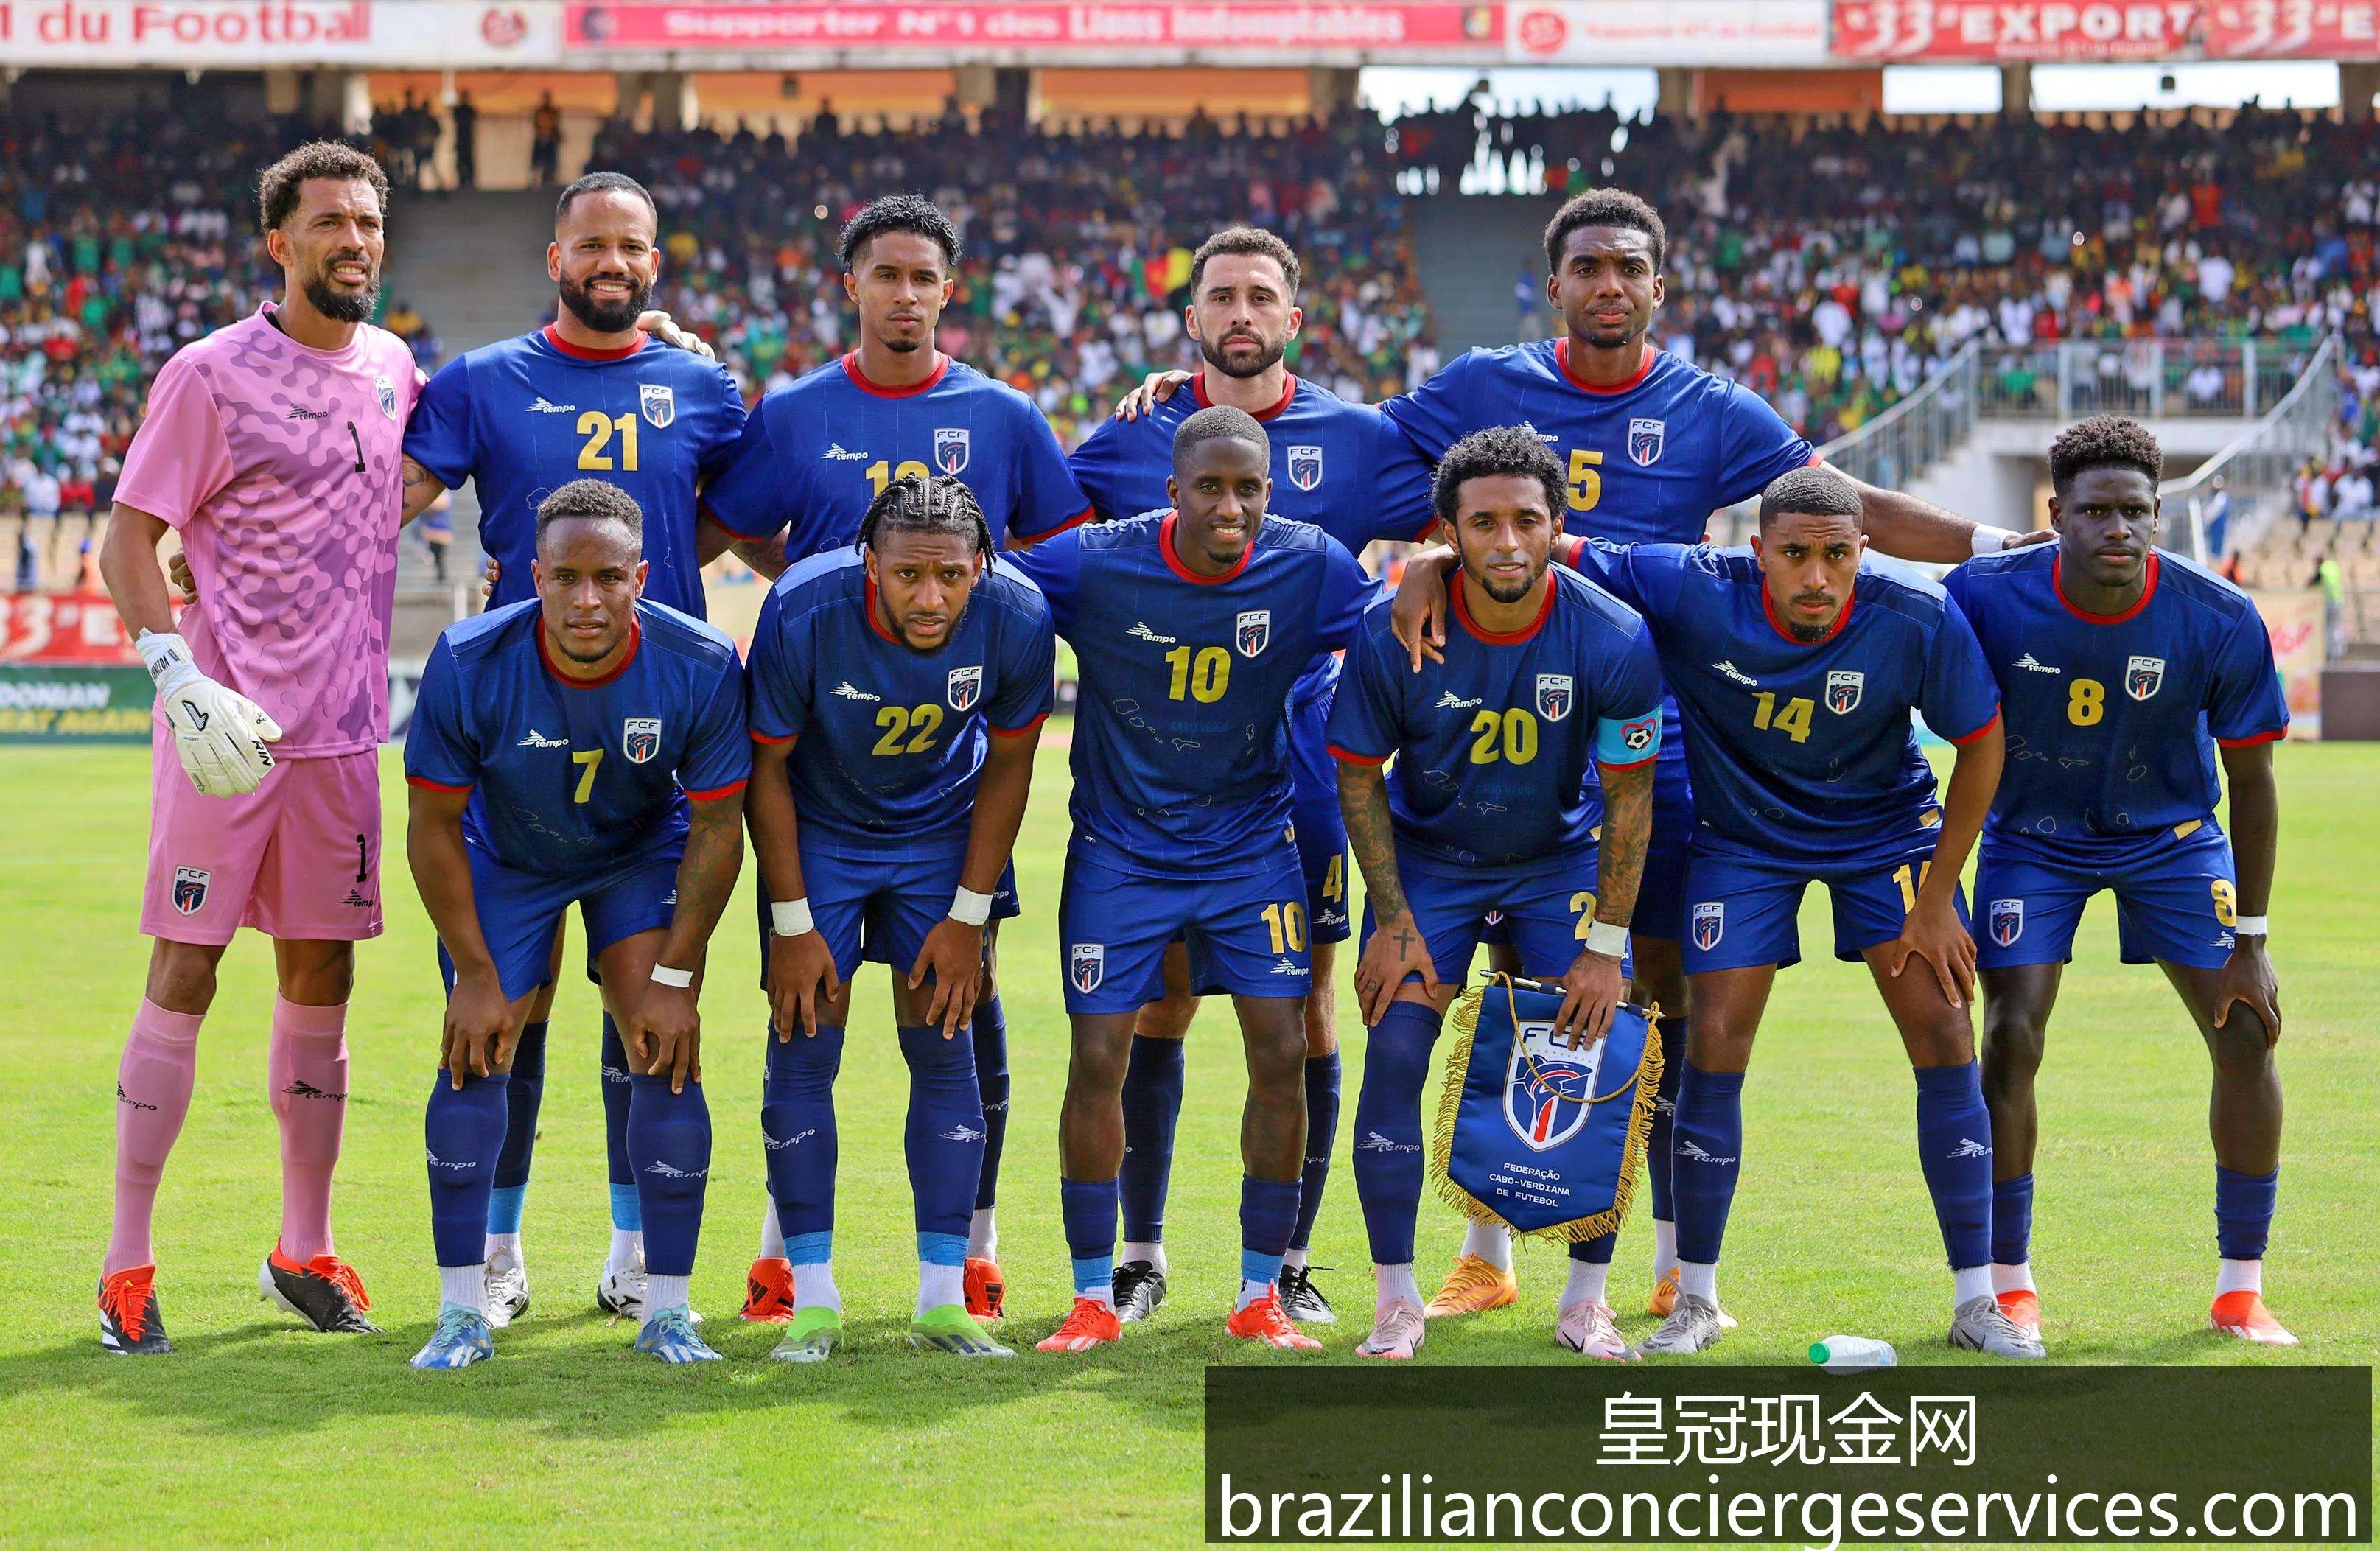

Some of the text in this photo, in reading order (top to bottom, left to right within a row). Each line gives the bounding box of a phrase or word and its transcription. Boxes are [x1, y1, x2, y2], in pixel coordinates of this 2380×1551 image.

[38, 1, 108, 43] du
[133, 0, 371, 43] Football
[1961, 2, 2194, 43] EXPORT
[299, 410, 328, 420] tempo
[543, 404, 576, 414] tempo
[1632, 421, 1661, 430] FCF
[937, 430, 965, 438] FCF
[347, 421, 365, 473] 1
[577, 410, 638, 472] 21
[836, 451, 869, 461] tempo
[1568, 449, 1603, 512] 5
[1239, 613, 1267, 623] FCF
[1142, 632, 1176, 644] tempo
[2029, 663, 2061, 674] tempo
[2131, 658, 2163, 668] FCF
[951, 668, 979, 679] FCF
[1165, 645, 1231, 704] 10
[1726, 669, 1758, 687] tempo
[1830, 673, 1861, 682] FCF
[1539, 676, 1569, 685] FCF
[847, 691, 881, 702] tempo
[1450, 697, 1483, 709] tempo
[2068, 678, 2105, 727] 8
[1751, 691, 1816, 743] 14
[627, 721, 658, 729] FCF
[872, 703, 944, 756] 22
[1470, 707, 1539, 766] 20
[535, 738, 569, 749] tempo
[572, 748, 604, 804] 7
[357, 833, 368, 883] 1
[178, 868, 208, 879] FCF
[1322, 854, 1343, 903] 4
[1695, 905, 1721, 914] FCF
[1992, 901, 2020, 911] FCF
[2211, 878, 2237, 928] 8
[1259, 900, 1308, 955] 10
[1074, 946, 1101, 955] FCF
[119, 1095, 158, 1111] tempo
[767, 1127, 816, 1150] tempo
[1378, 1142, 1421, 1154] tempo
[430, 1158, 477, 1171] tempo
[1694, 1152, 1737, 1166] tempo
[1503, 1163, 1561, 1180] FEDERAÇÃO
[1489, 1173, 1571, 1197] CABO-VERDIANA
[1496, 1188, 1558, 1208] DE FUTEBOL
